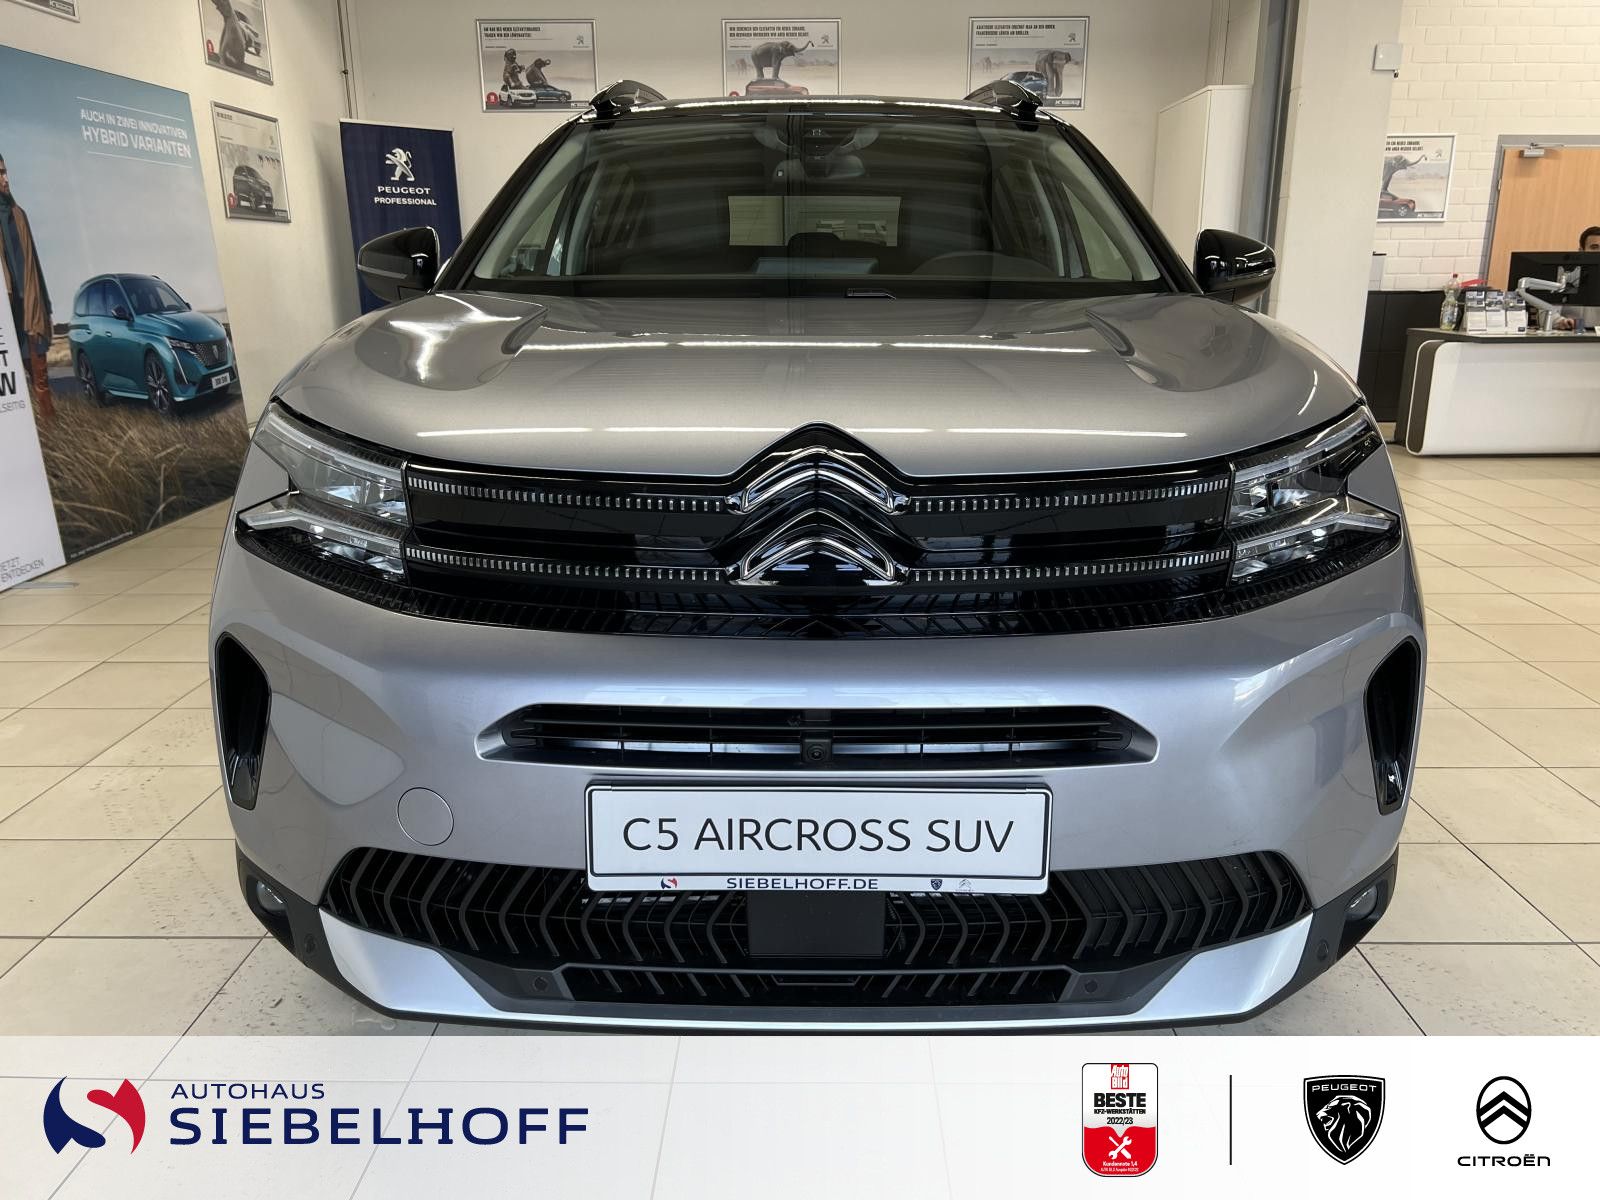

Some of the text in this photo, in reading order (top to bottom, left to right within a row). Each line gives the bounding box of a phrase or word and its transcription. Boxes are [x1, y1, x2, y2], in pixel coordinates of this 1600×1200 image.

[80, 109, 188, 140] AUCH IN ZWEI INNOVATIVEN
[82, 126, 191, 158] HYBRID VARIANTEN
[377, 186, 431, 194] PEUGEOT
[374, 197, 437, 206] PROFESSIONAL
[622, 817, 1014, 852] C5 AIRCROSS SUV
[726, 878, 879, 890] SIEBELHOFF.DE
